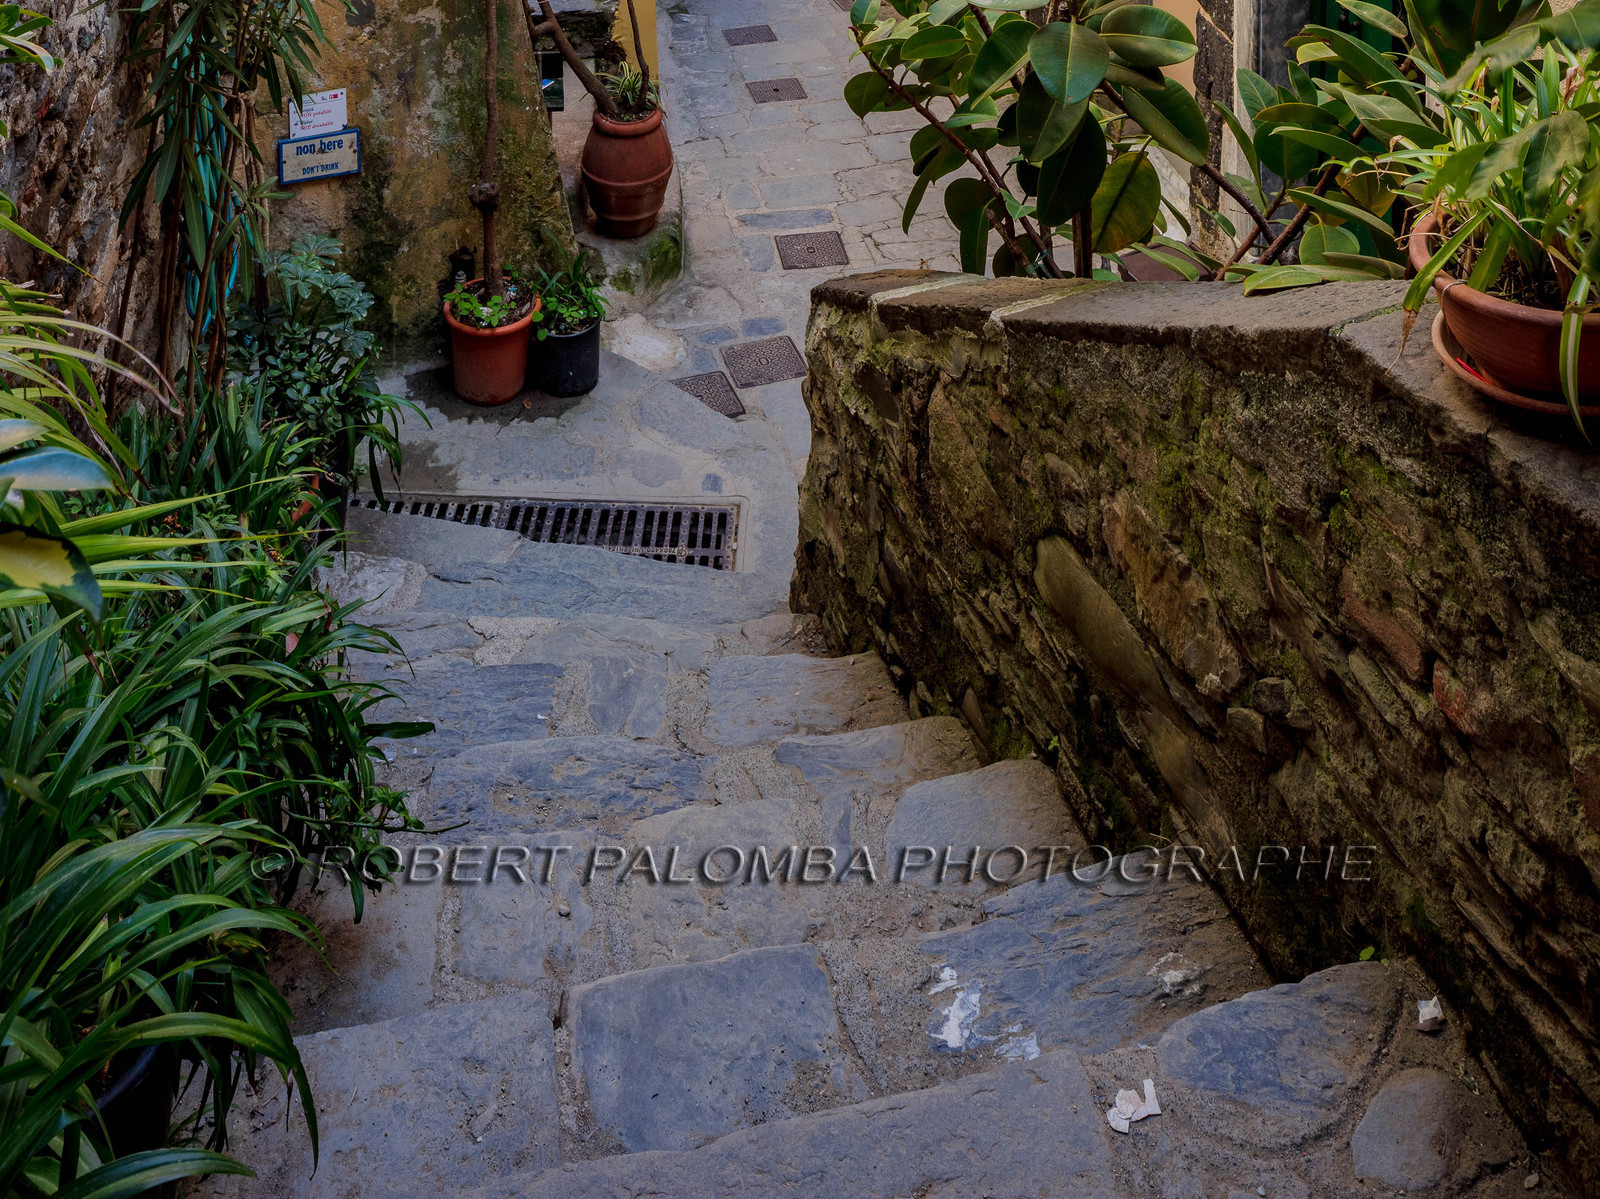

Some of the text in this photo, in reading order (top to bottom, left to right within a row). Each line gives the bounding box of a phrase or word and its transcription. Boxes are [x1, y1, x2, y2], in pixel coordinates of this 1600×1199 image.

[296, 139, 344, 156] non bere
[302, 162, 339, 175] DON'T DRINK
